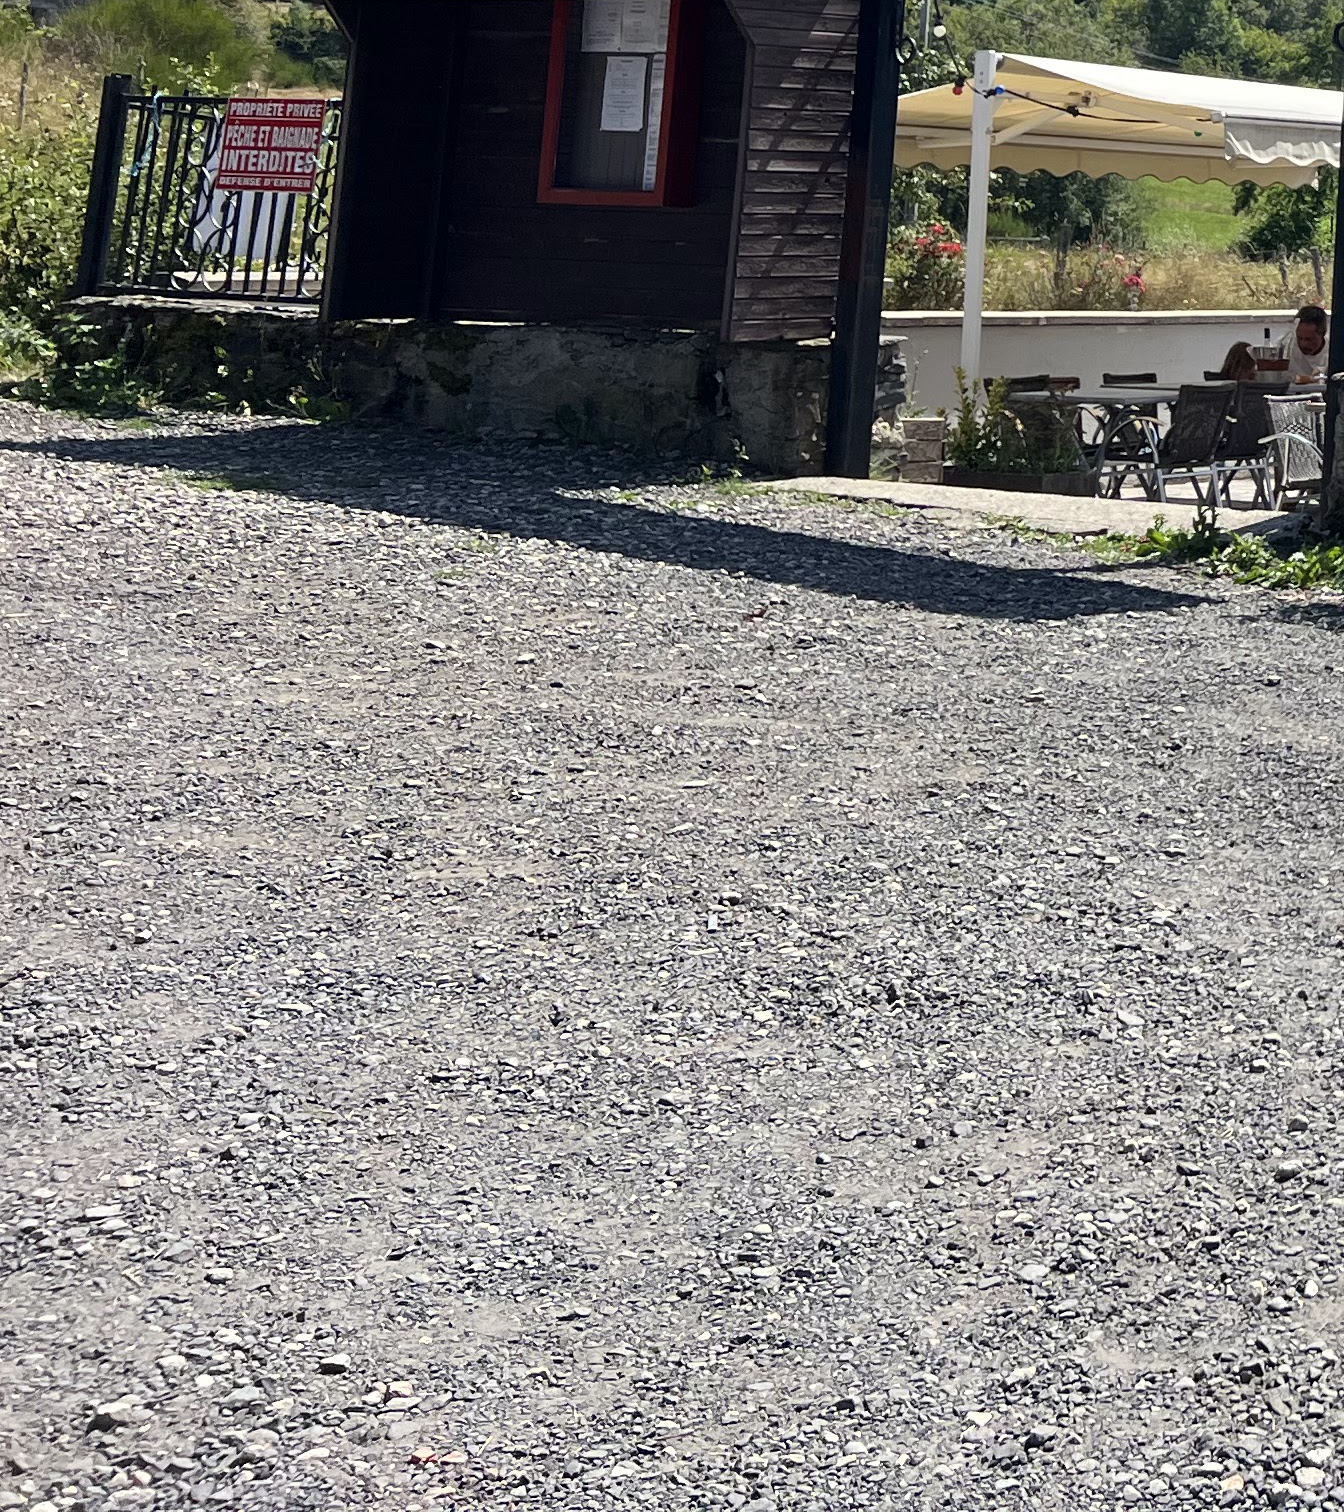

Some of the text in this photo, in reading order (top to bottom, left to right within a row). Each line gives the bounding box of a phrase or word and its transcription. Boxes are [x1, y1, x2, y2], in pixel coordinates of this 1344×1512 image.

[226, 120, 319, 149] PÊCHE ET BAIGNADE
[222, 149, 316, 173] INTERDITES
